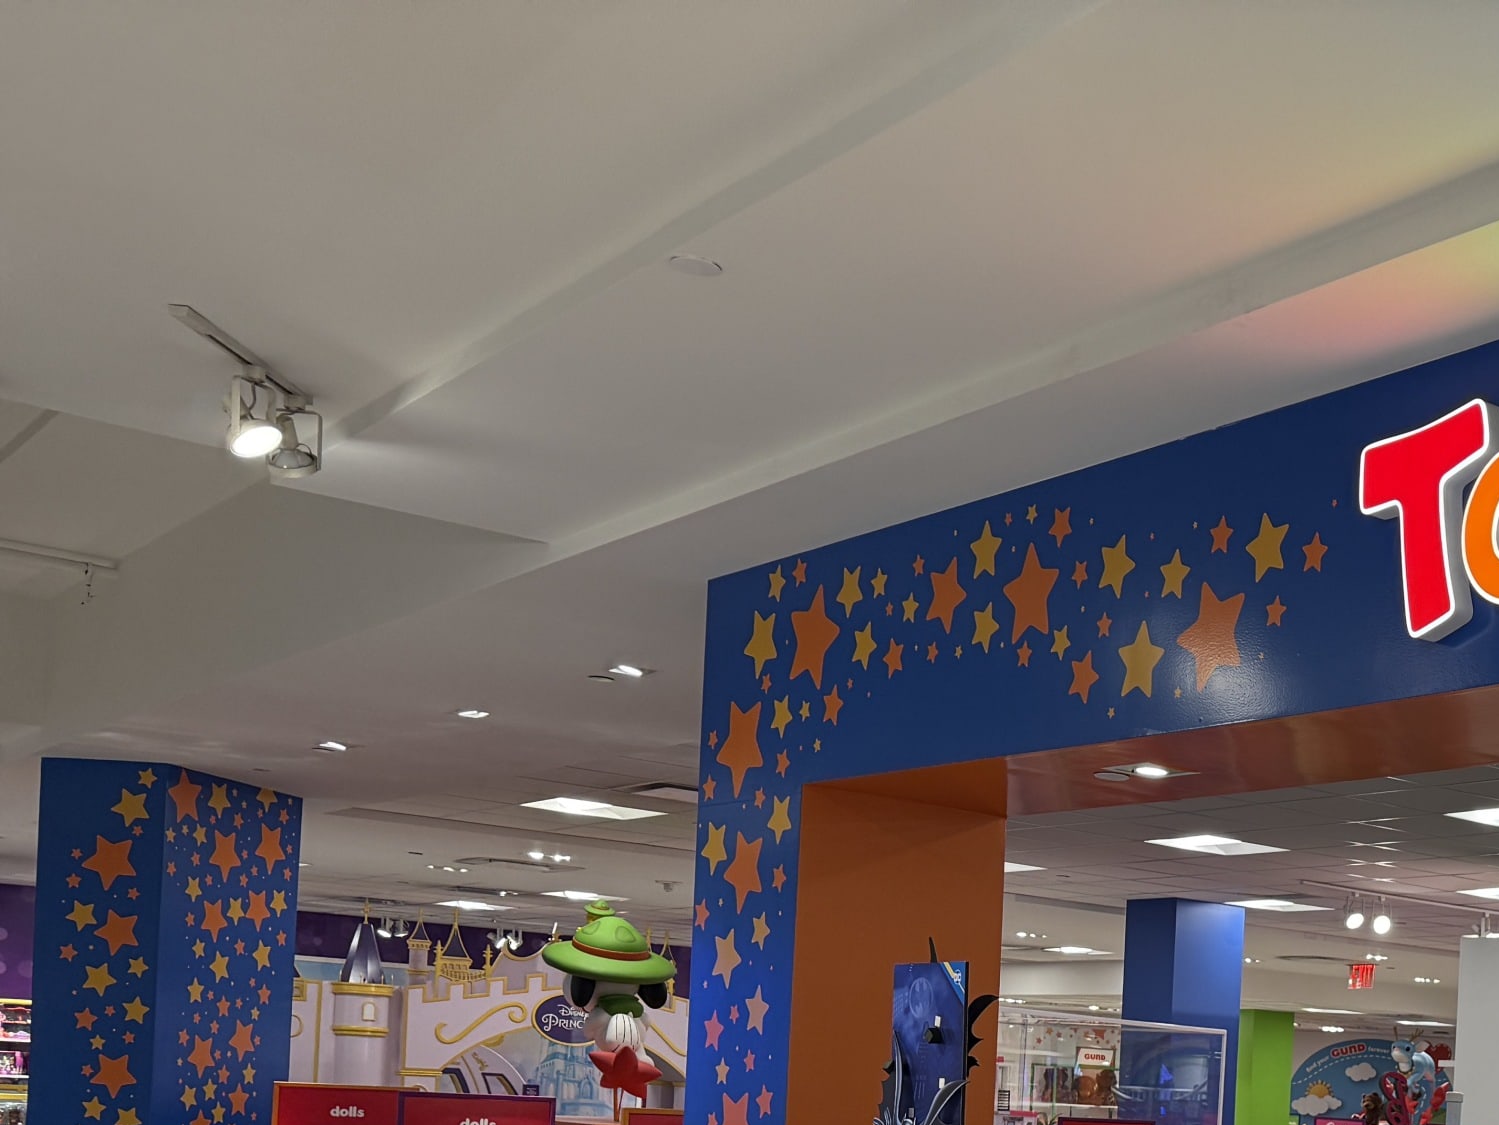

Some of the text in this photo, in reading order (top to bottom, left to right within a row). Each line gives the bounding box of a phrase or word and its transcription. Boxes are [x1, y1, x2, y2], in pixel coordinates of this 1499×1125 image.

[1349, 965, 1375, 989] EXIT
[541, 1013, 584, 1032] PRINC
[1084, 1053, 1106, 1061] GUND
[1331, 1044, 1366, 1059] GUND
[330, 1106, 365, 1118] dolls
